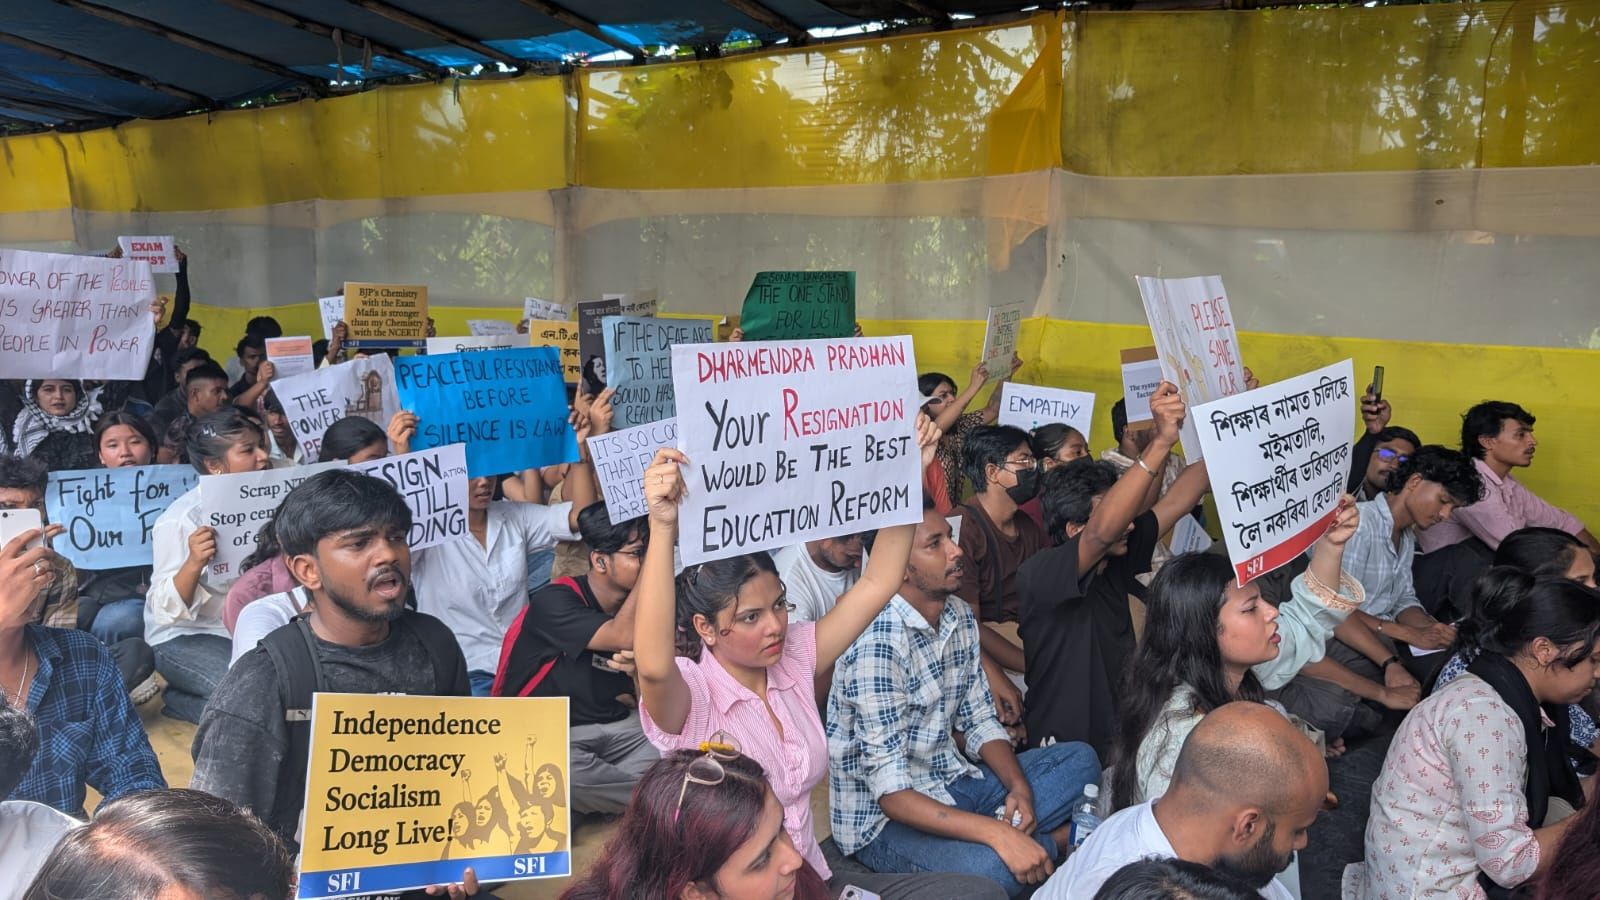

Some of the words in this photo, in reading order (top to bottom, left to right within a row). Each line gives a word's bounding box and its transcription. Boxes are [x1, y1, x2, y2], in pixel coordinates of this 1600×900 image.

[131, 242, 164, 252] EXAM
[0, 270, 40, 290] OWER
[47, 272, 73, 291] OF
[75, 273, 104, 292] THE
[110, 265, 151, 292] PEOPLE
[359, 288, 380, 298] BJP's
[381, 288, 417, 299] Chemistry
[361, 298, 380, 308] with
[381, 299, 394, 308] the
[395, 299, 416, 308] Exam
[755, 284, 781, 304] THE
[789, 284, 814, 303] ONE
[817, 283, 850, 304] STAND
[30, 299, 92, 323] GREATER
[100, 303, 140, 321] THAN
[351, 317, 370, 327] than
[371, 319, 384, 328] my
[385, 318, 424, 329] Chemistry
[356, 308, 379, 318] Mafia
[381, 308, 388, 318] is
[389, 310, 420, 321] stronger
[775, 310, 803, 330] FOR
[1190, 296, 1231, 334] PLEASE
[55, 335, 79, 354] IN
[88, 324, 140, 355] POWER
[354, 328, 370, 337] with
[372, 328, 387, 337] the
[388, 328, 420, 337] NCERT!
[612, 321, 627, 352] IF
[627, 321, 654, 352] THE
[657, 325, 689, 351] DEAF
[697, 347, 816, 384] DHARMENDRA
[827, 341, 906, 372] PRADHAN
[1209, 339, 1235, 368] SAVE
[399, 359, 491, 390] PEACEFUL
[625, 357, 644, 381] TO
[651, 356, 673, 380] HE
[292, 388, 333, 412] THE
[462, 387, 533, 411] BEFORE
[612, 385, 650, 406] SOUND
[1009, 395, 1081, 420] EMPATHY
[1210, 405, 1271, 442] শিক্ষাৰ
[1271, 390, 1311, 421] নামত
[1311, 376, 1350, 407] চলিছে
[290, 407, 341, 438] POWER
[625, 404, 665, 424] REALLY
[782, 388, 904, 441] RESIGNATION
[424, 419, 500, 447] SILENCE
[509, 419, 527, 438] IS
[532, 416, 566, 438] LAW
[592, 436, 624, 460] IT'S
[627, 430, 649, 451] SO
[1258, 417, 1326, 463] মইমতালি,
[302, 438, 321, 458] PE
[598, 456, 635, 483] THAT
[701, 460, 767, 493] WOULD
[775, 450, 798, 484] BE
[810, 443, 852, 472] THE
[864, 434, 911, 463] BEST
[56, 473, 116, 517] Fight
[129, 470, 170, 514] for
[239, 484, 281, 500] Scrap
[284, 477, 306, 493] NT
[406, 482, 459, 518] TILL
[1231, 463, 1299, 513] শিক্ষাৰ্থীৰ
[210, 511, 247, 527] Stop
[249, 508, 275, 521] cen
[408, 508, 467, 548] DING
[702, 503, 820, 553] EDUCATION
[828, 480, 910, 527] REFORM
[1232, 521, 1263, 549] লৈ
[1263, 495, 1309, 536] নকৰিবা
[69, 515, 124, 552] Our
[232, 531, 252, 547] of
[252, 533, 262, 544] e
[213, 562, 229, 576] SFI
[1246, 555, 1264, 579] SFI
[331, 710, 502, 742] Independence
[328, 748, 466, 777] Democracy
[325, 783, 441, 812] Socialism
[321, 824, 390, 855] Long
[396, 818, 454, 846] Live!
[514, 856, 546, 876] SFI
[327, 871, 361, 893] SFI
